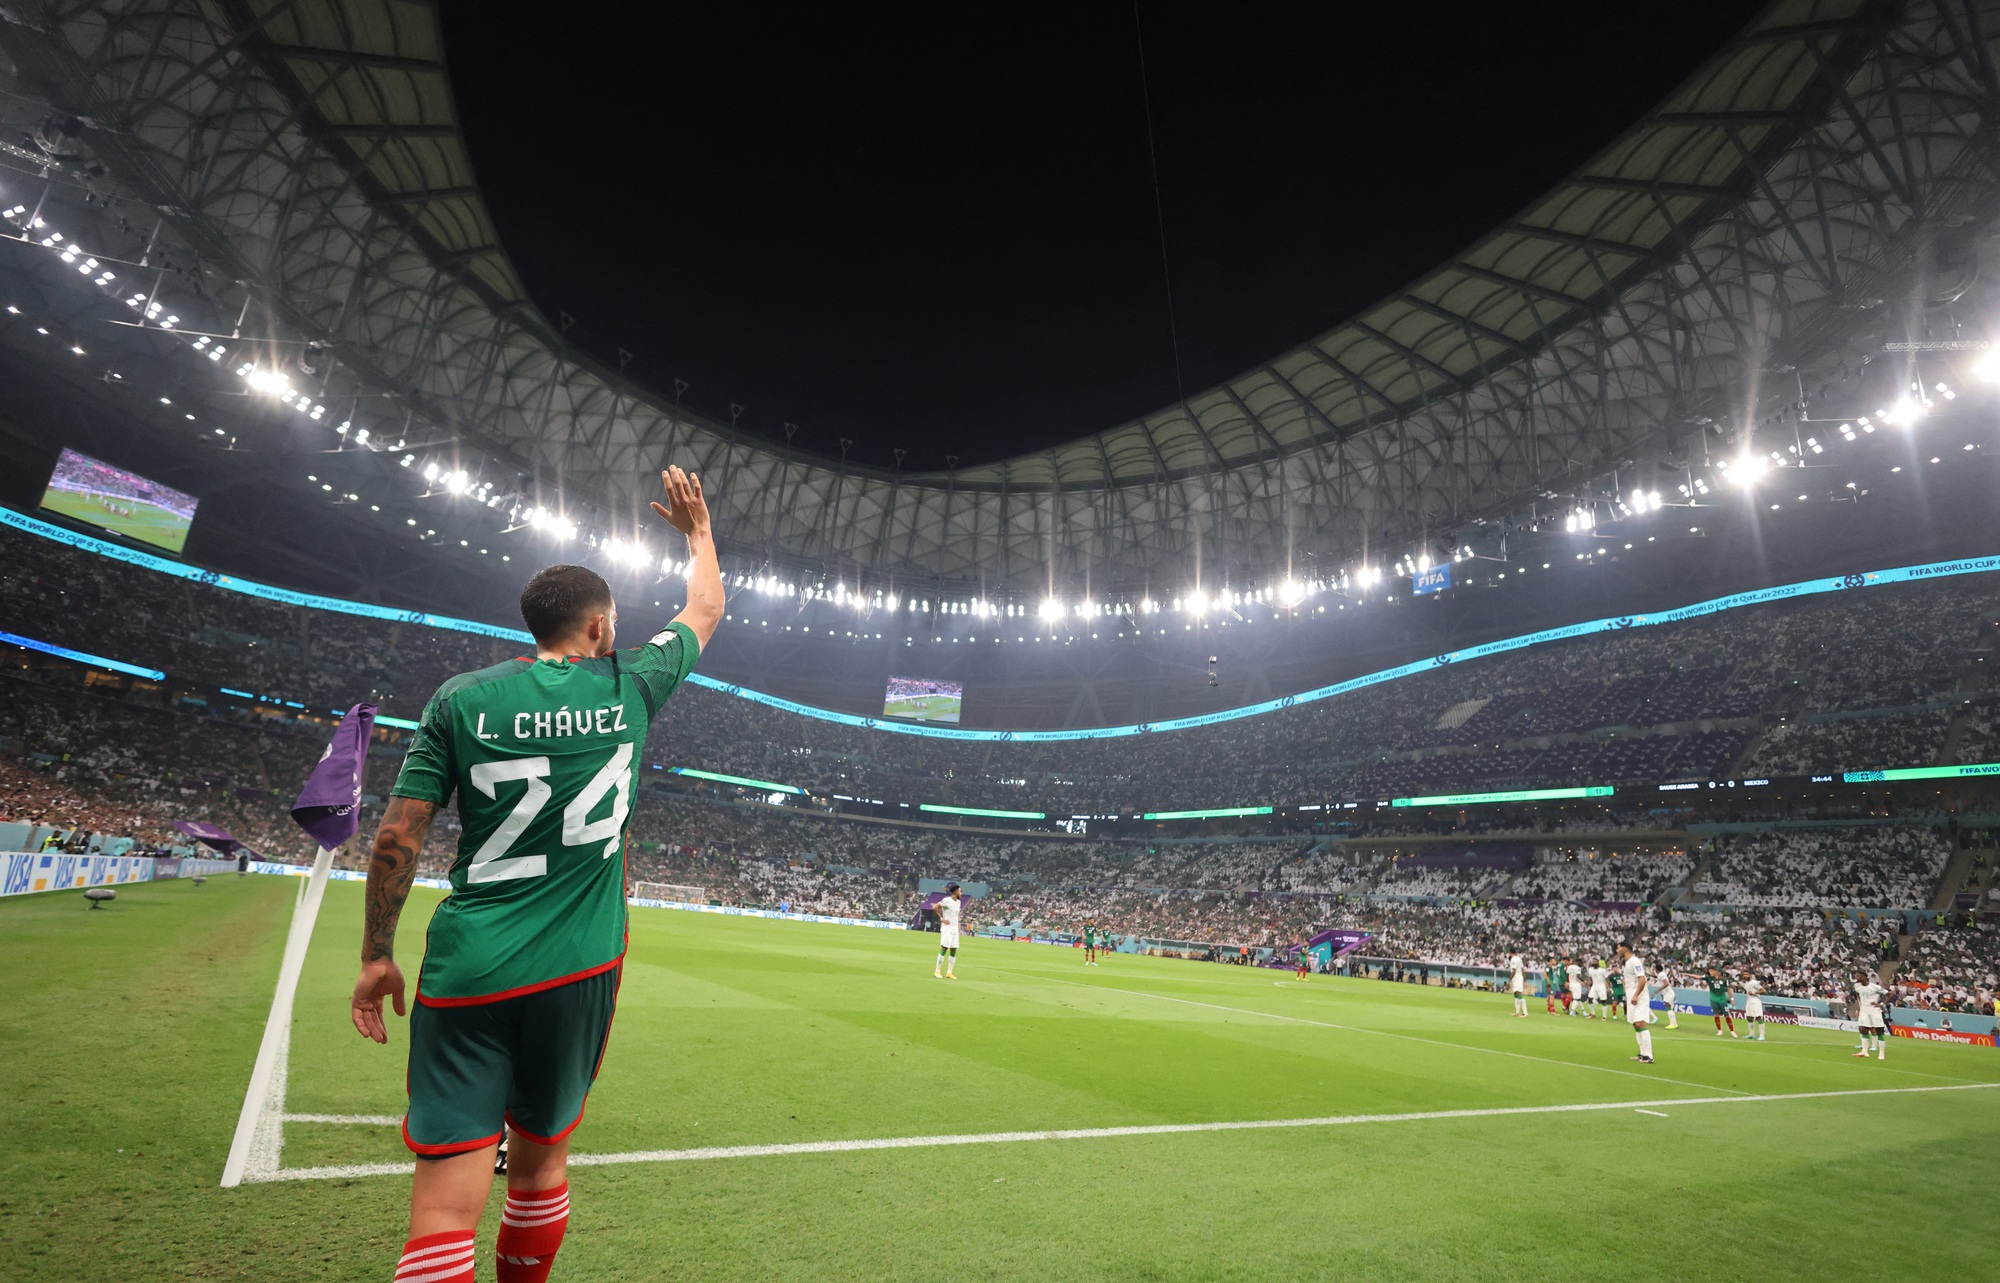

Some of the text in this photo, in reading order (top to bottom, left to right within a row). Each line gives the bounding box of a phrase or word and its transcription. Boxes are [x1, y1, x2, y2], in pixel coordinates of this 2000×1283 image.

[4, 513, 27, 527] FIFA
[28, 522, 65, 539] WORLD
[66, 534, 87, 545] CUP
[1909, 560, 1996, 576] FIFA WORLD CUP
[1418, 572, 1445, 588] FIFA
[1668, 611, 1685, 620] FIFA
[1685, 604, 1714, 616] WORLD
[1715, 599, 1731, 608] CUP
[1478, 646, 1492, 654] FIFA
[1492, 641, 1516, 651] WORLD
[1516, 638, 1530, 646] CUP
[1331, 683, 1352, 694] WORLD
[1352, 679, 1364, 687] CUP
[477, 704, 627, 739] L. CHÁVEZ
[1186, 717, 1205, 726] WORLD
[1205, 715, 1216, 723] CUP
[1960, 767, 1981, 775] FIFA
[467, 742, 634, 884] 24
[4, 855, 35, 894] VISA
[54, 856, 77, 889] VISA
[90, 857, 108, 885] VISA
[256, 863, 285, 875] VISA
[638, 899, 658, 908] VISA
[681, 903, 701, 912] VISA
[723, 907, 742, 916] VISA
[763, 911, 781, 919] VISA
[801, 914, 819, 923] VISA
[838, 918, 854, 926] VISA
[874, 921, 890, 929] VISA
[1911, 1030, 1930, 1040] We
[1931, 1033, 1971, 1044] Deliver
